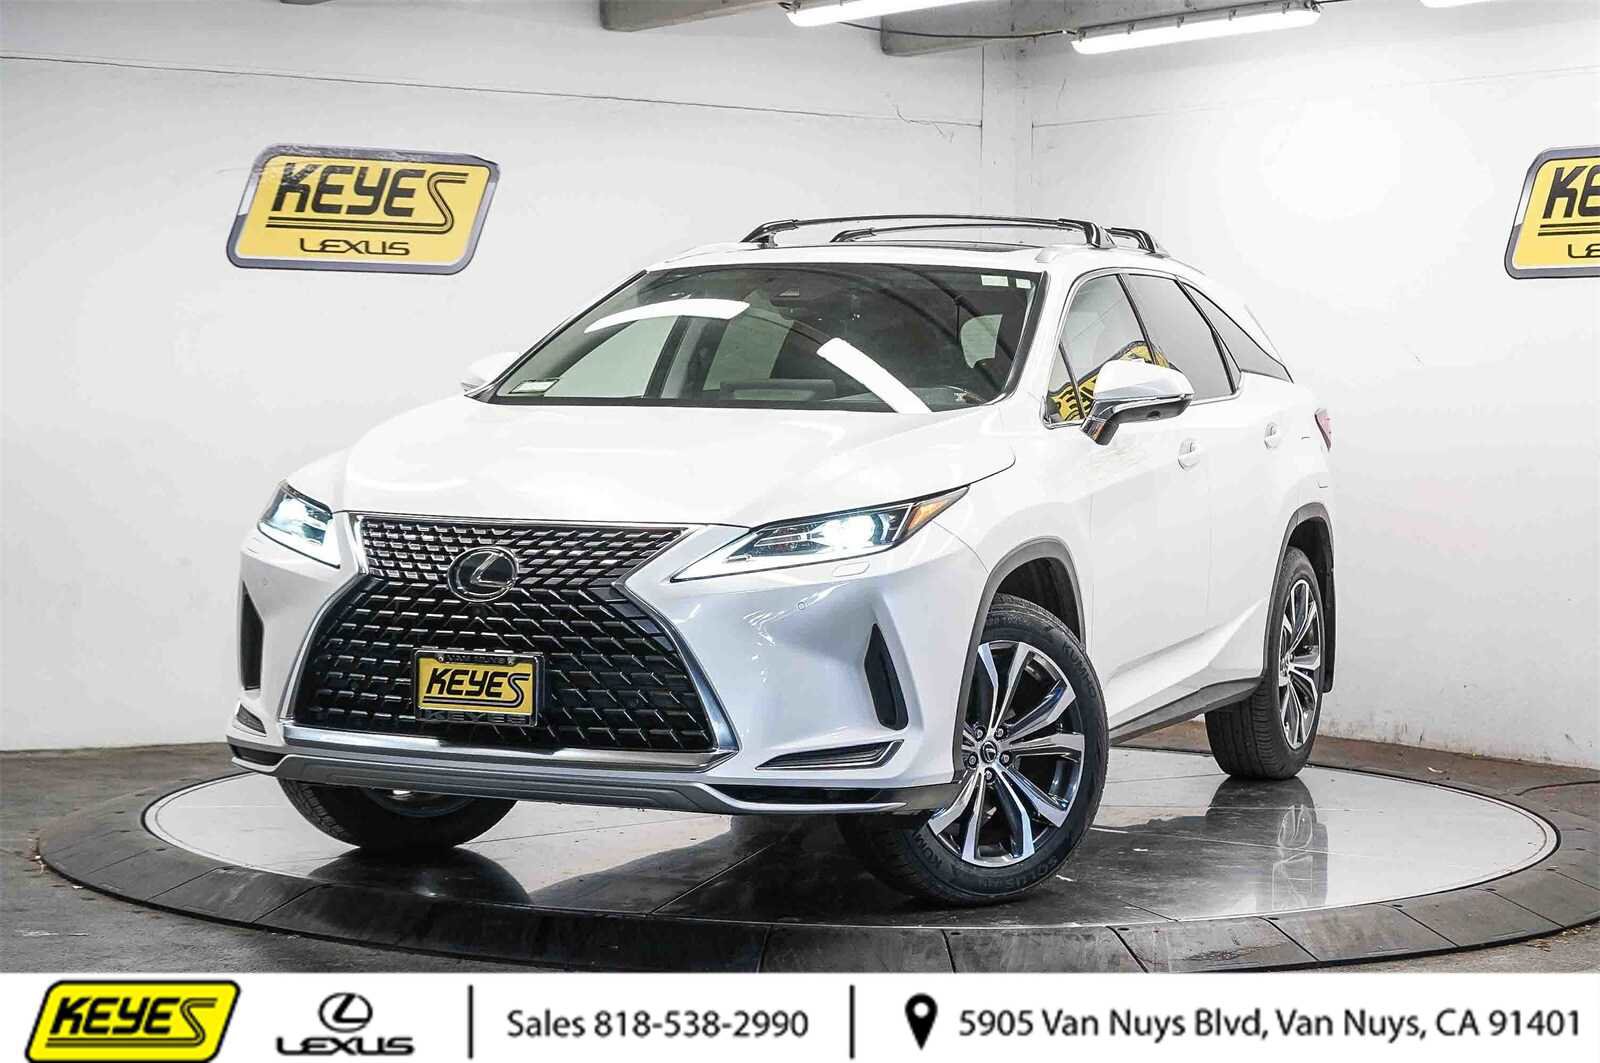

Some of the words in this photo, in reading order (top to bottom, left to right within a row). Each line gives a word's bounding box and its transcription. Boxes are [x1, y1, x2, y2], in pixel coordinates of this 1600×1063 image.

[266, 162, 469, 234] KEYES
[299, 237, 411, 256] LEXUS
[423, 667, 531, 708] KEYES
